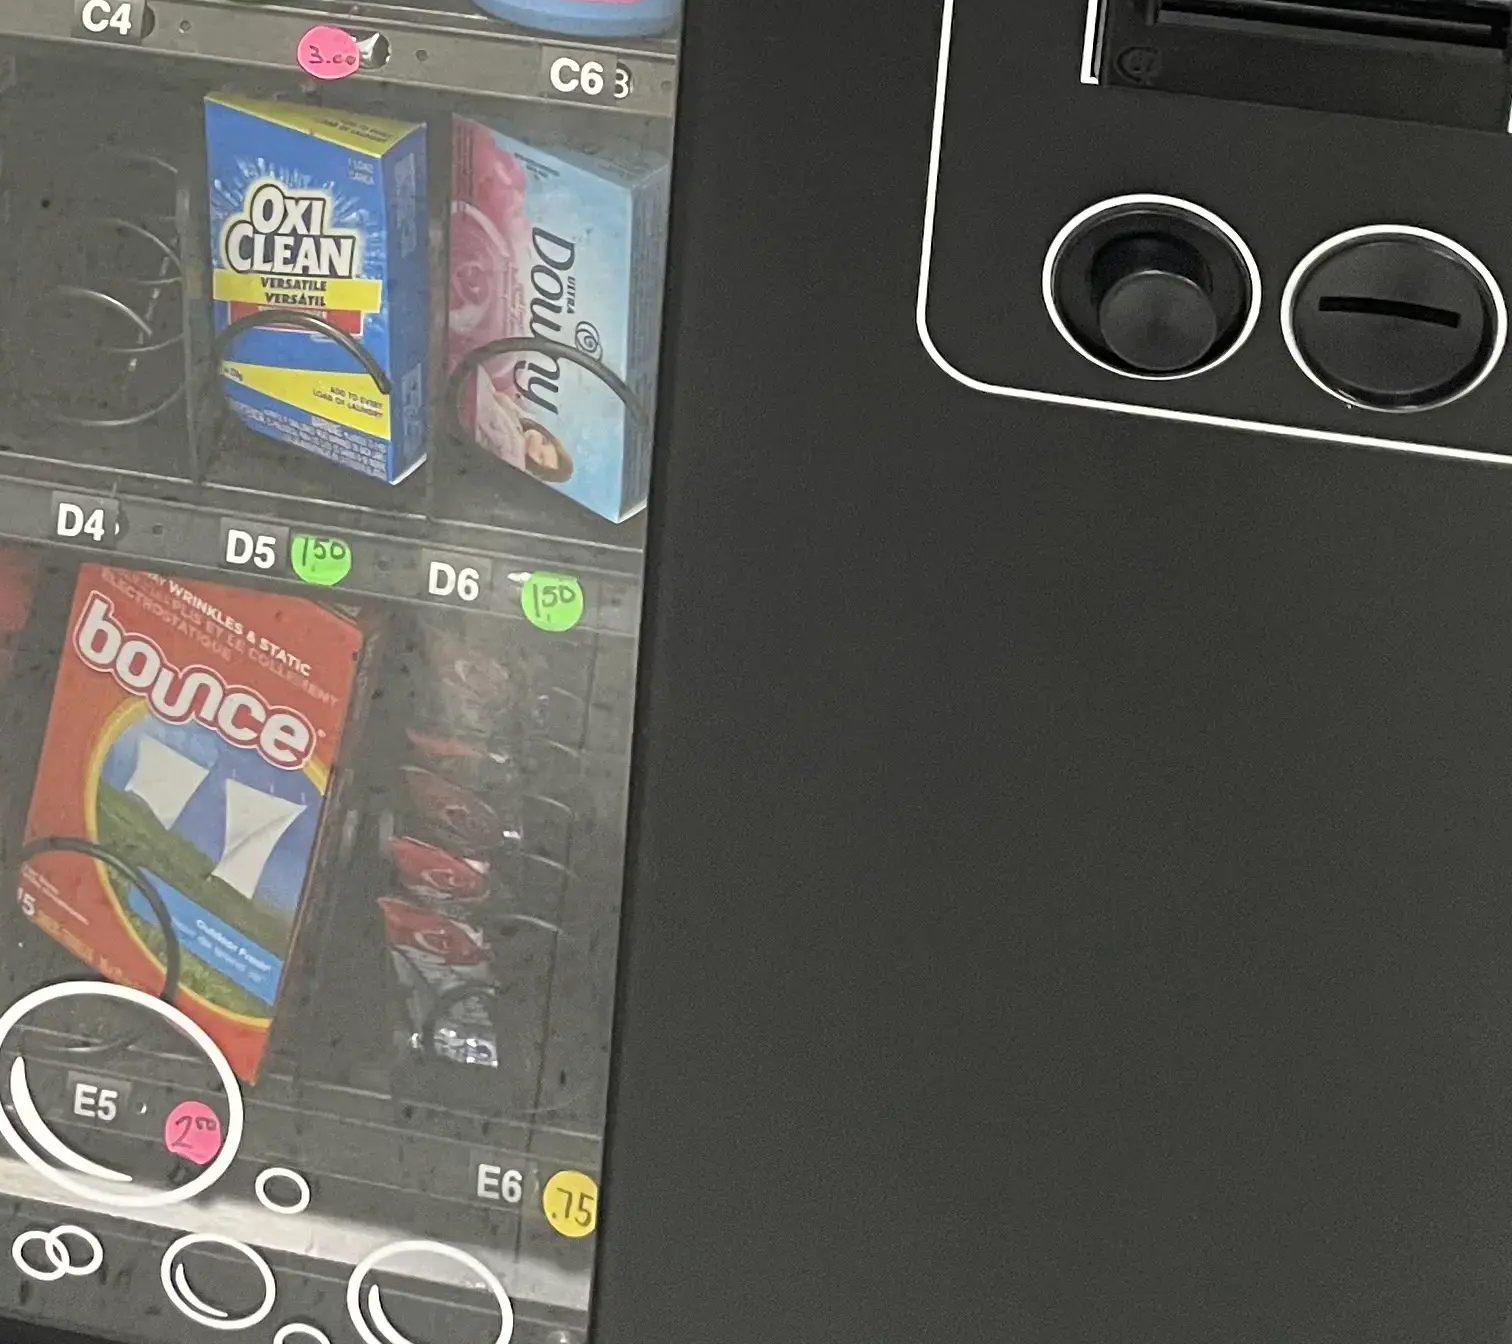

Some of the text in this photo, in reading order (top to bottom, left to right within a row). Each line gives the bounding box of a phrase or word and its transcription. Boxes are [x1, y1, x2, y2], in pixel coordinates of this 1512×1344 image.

[548, 56, 605, 97] C6
[251, 184, 327, 236] OXI
[226, 220, 356, 279] CLEAN
[260, 276, 327, 292] VERSATILE
[513, 226, 576, 415] Downy
[57, 502, 106, 542] D4
[225, 530, 277, 570] D5
[427, 561, 480, 602] D6
[168, 580, 312, 677] WRINKLES & STATIC
[77, 595, 314, 769] bounce
[72, 1084, 119, 1123] E5
[476, 1164, 523, 1204] E6
